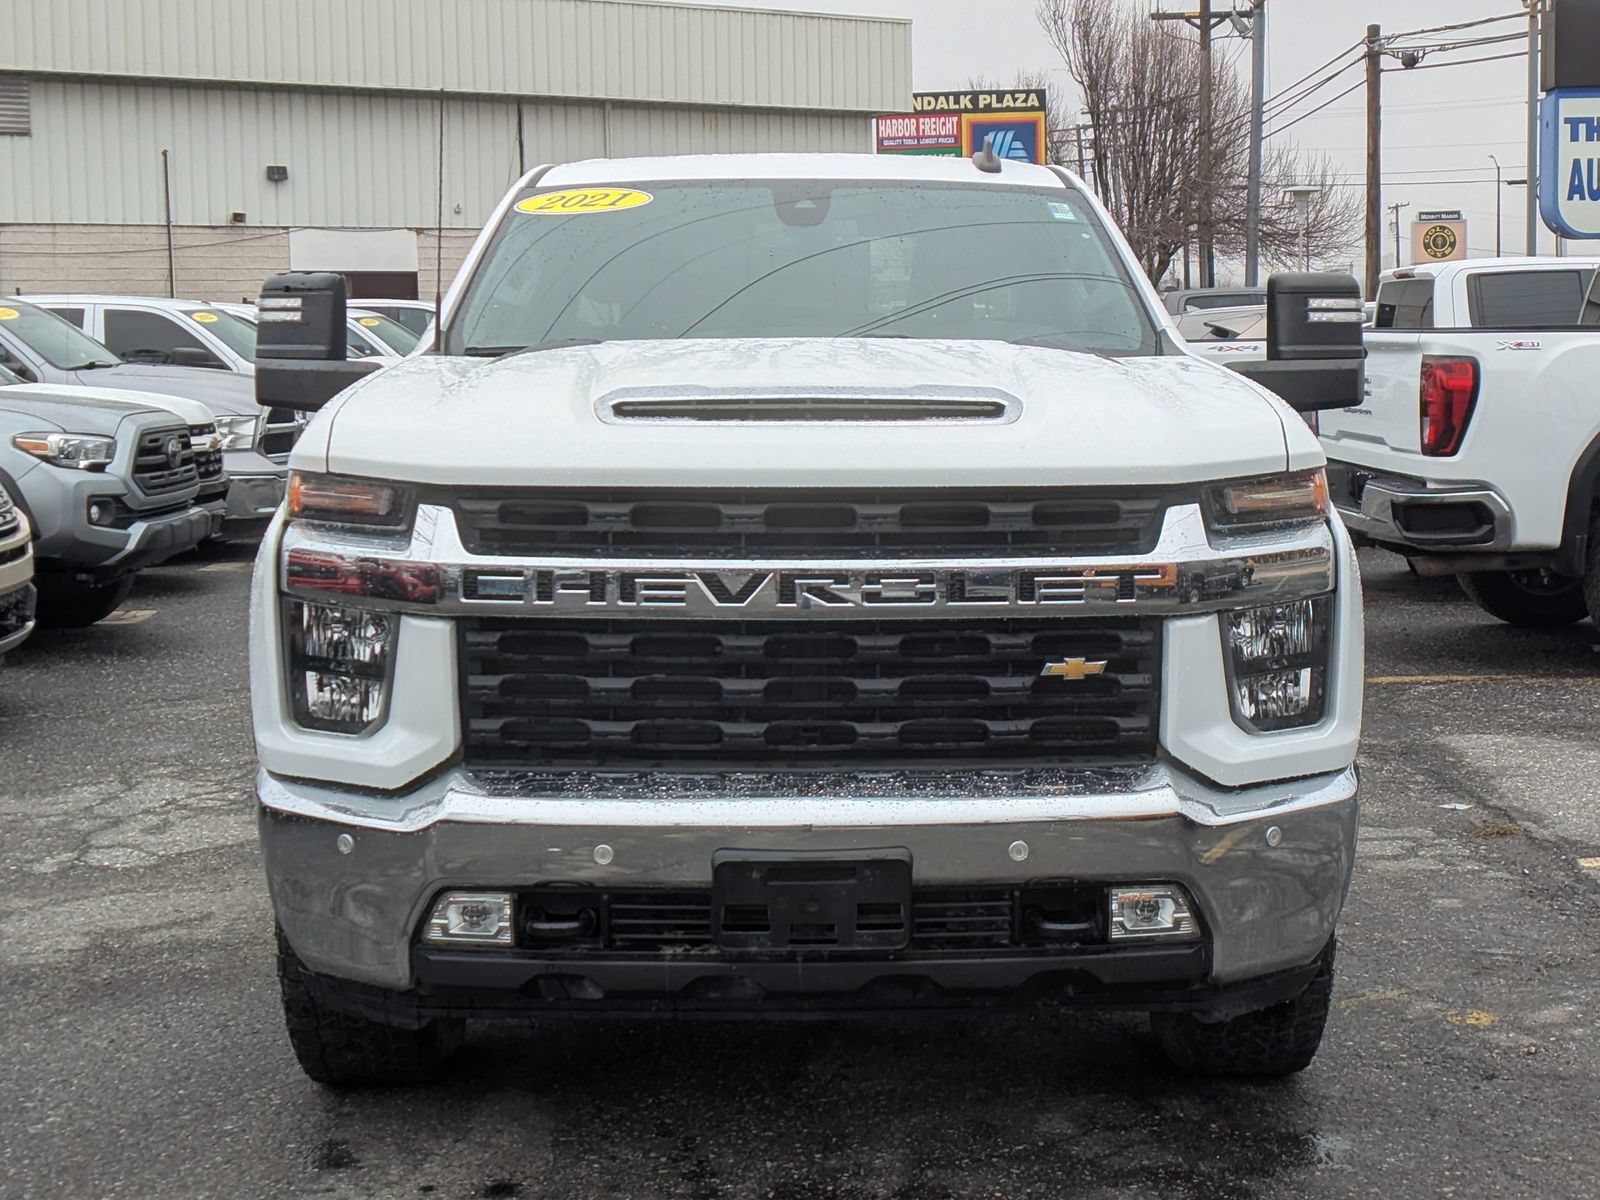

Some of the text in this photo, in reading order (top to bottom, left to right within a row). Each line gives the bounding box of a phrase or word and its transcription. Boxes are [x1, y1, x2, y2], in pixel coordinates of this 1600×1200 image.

[978, 92, 1040, 107] PLAZA
[879, 116, 959, 138] HARBOR FREIGHT
[534, 192, 633, 210] 2021
[460, 569, 1163, 604] CHEVROLET
